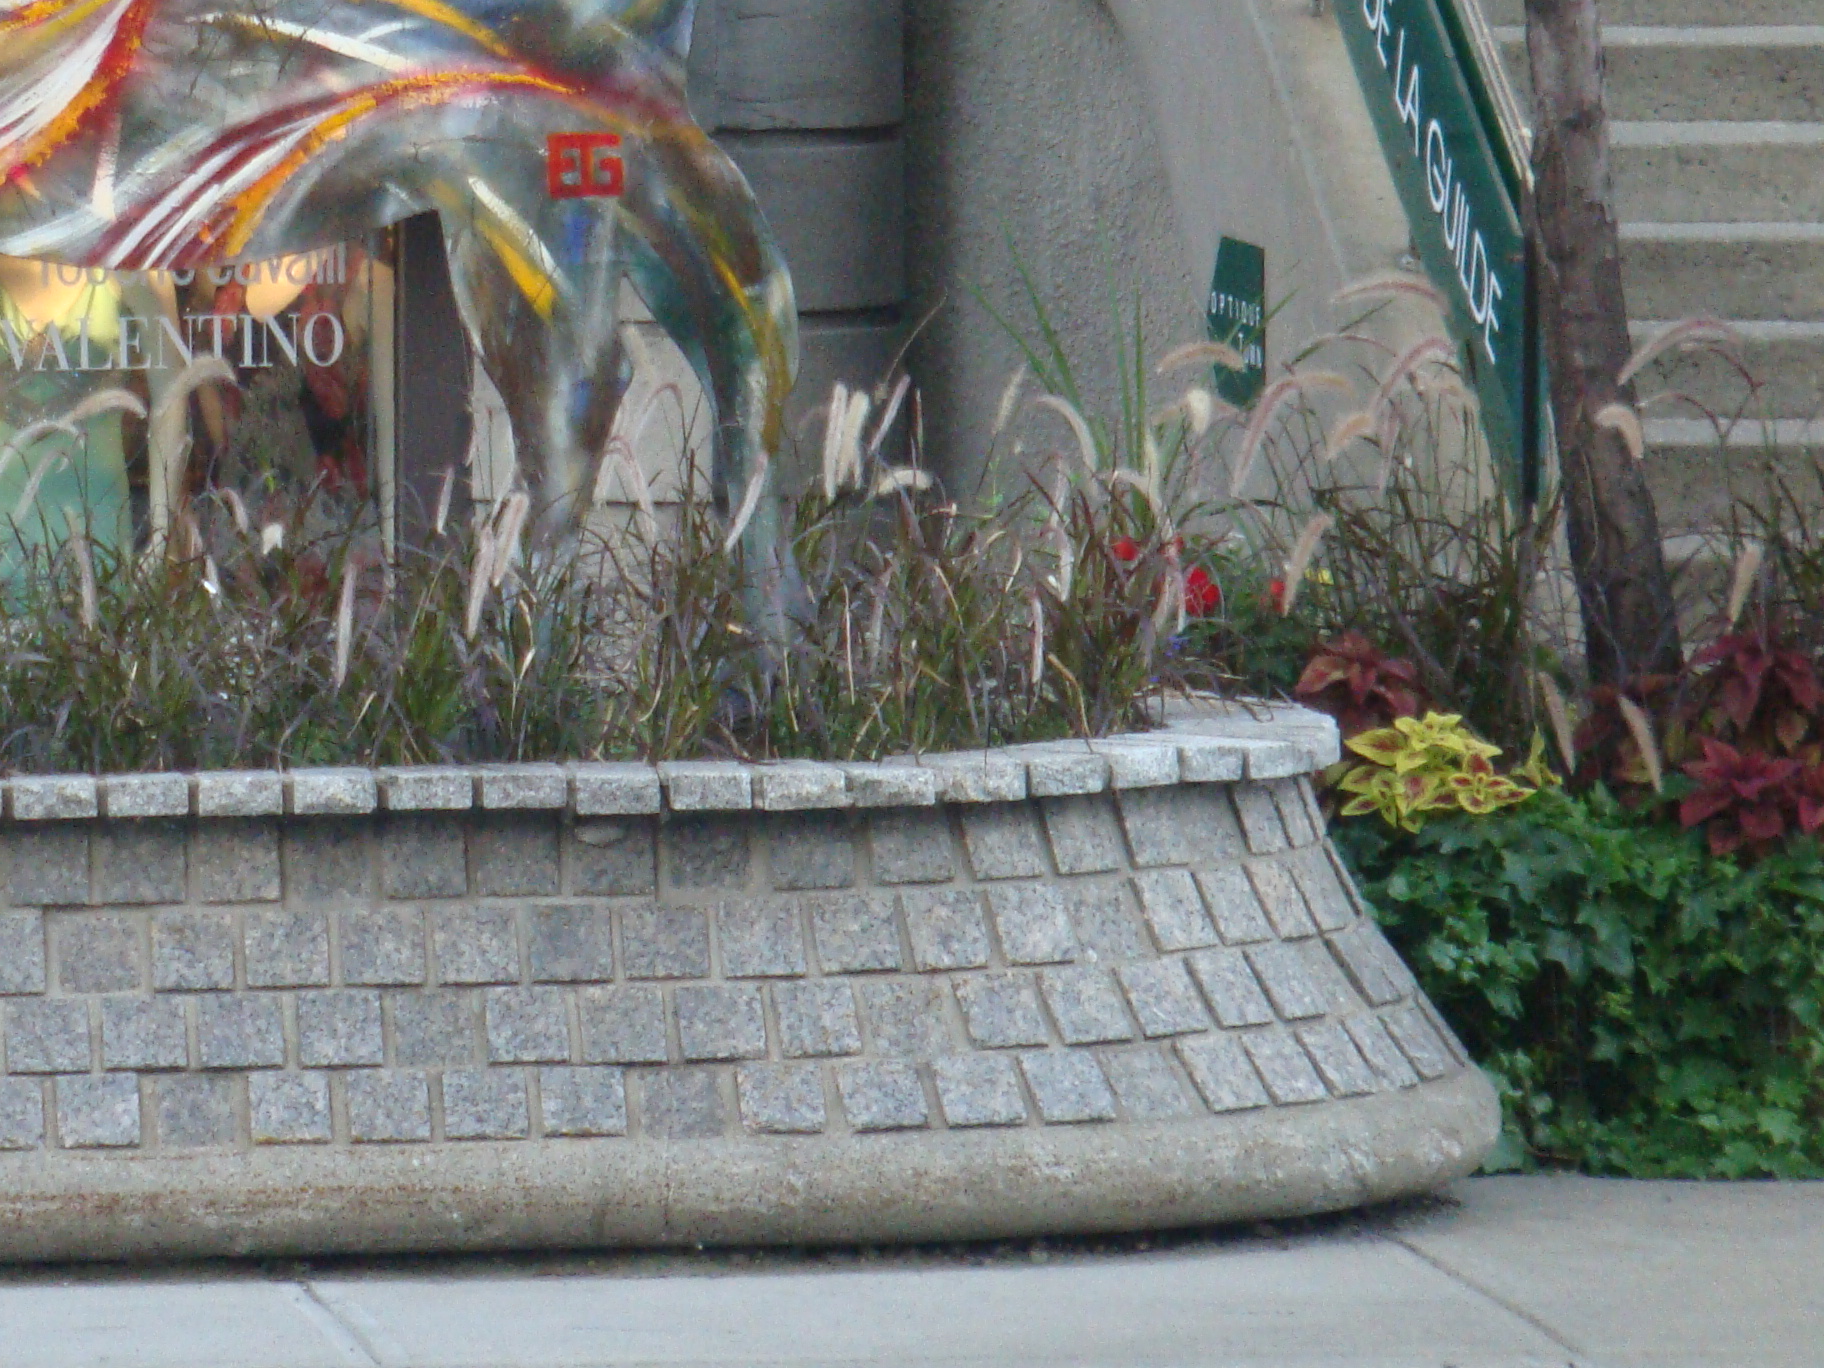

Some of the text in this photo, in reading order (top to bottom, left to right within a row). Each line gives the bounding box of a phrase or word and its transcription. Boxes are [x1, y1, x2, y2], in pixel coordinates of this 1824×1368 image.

[1394, 27, 1422, 158] LA
[1425, 117, 1504, 366] GUILDE
[1, 312, 344, 372] VALENTINO
